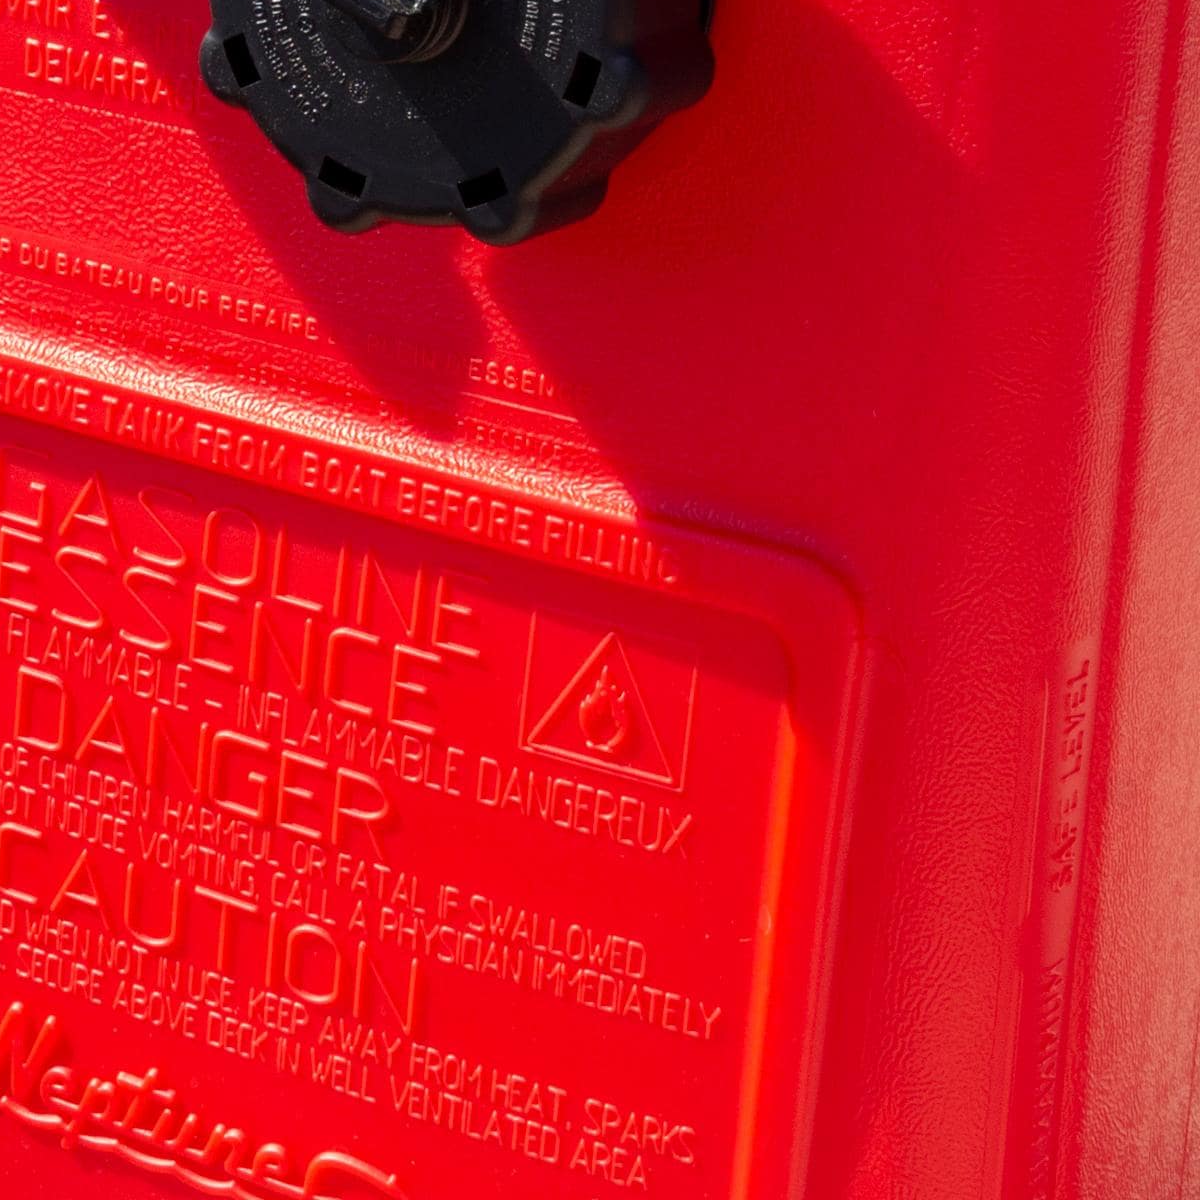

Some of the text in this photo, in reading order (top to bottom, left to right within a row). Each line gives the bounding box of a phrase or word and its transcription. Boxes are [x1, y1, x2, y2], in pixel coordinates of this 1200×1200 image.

[20, 242, 49, 270] DU
[55, 251, 143, 295] BATEAU
[102, 394, 184, 451] TANK
[194, 422, 287, 481] FROM
[302, 451, 387, 511] BOAT
[400, 477, 531, 547] BEFORE
[6, 612, 192, 712] FLAMMABLE
[237, 683, 464, 797] INFLAMMABLE
[477, 755, 693, 858] DANGEREUX
[12, 665, 391, 860] DANGER
[1060, 659, 1090, 780] LEVEL
[1, 740, 29, 778] OF
[37, 753, 150, 819] CHILDREN
[162, 792, 278, 867] HARMFUL
[291, 839, 327, 877] OR
[336, 852, 425, 916] FATAL
[437, 885, 460, 919] IF
[468, 893, 647, 980] SWALLOWED
[45, 795, 127, 854] INDUCE
[270, 872, 336, 926] CALL
[348, 899, 367, 935] A
[379, 906, 522, 984] PHYSICIAN
[533, 958, 722, 1041] IMMEDIATELY
[15, 944, 102, 1005] SECURE
[113, 980, 197, 1039] ABOVE
[206, 1011, 269, 1063] DECK
[276, 1037, 300, 1076] IN
[311, 1047, 377, 1104] WELL
[389, 1075, 561, 1165] VENTILATED
[570, 1137, 649, 1192] AREA
[25, 909, 91, 959] WHEN
[98, 934, 149, 976] NOT
[157, 957, 179, 992] IN
[248, 988, 309, 1036] KEEP
[318, 1016, 402, 1071] AWAY
[408, 1042, 482, 1099] FROM
[582, 1097, 697, 1165] SPARKS
